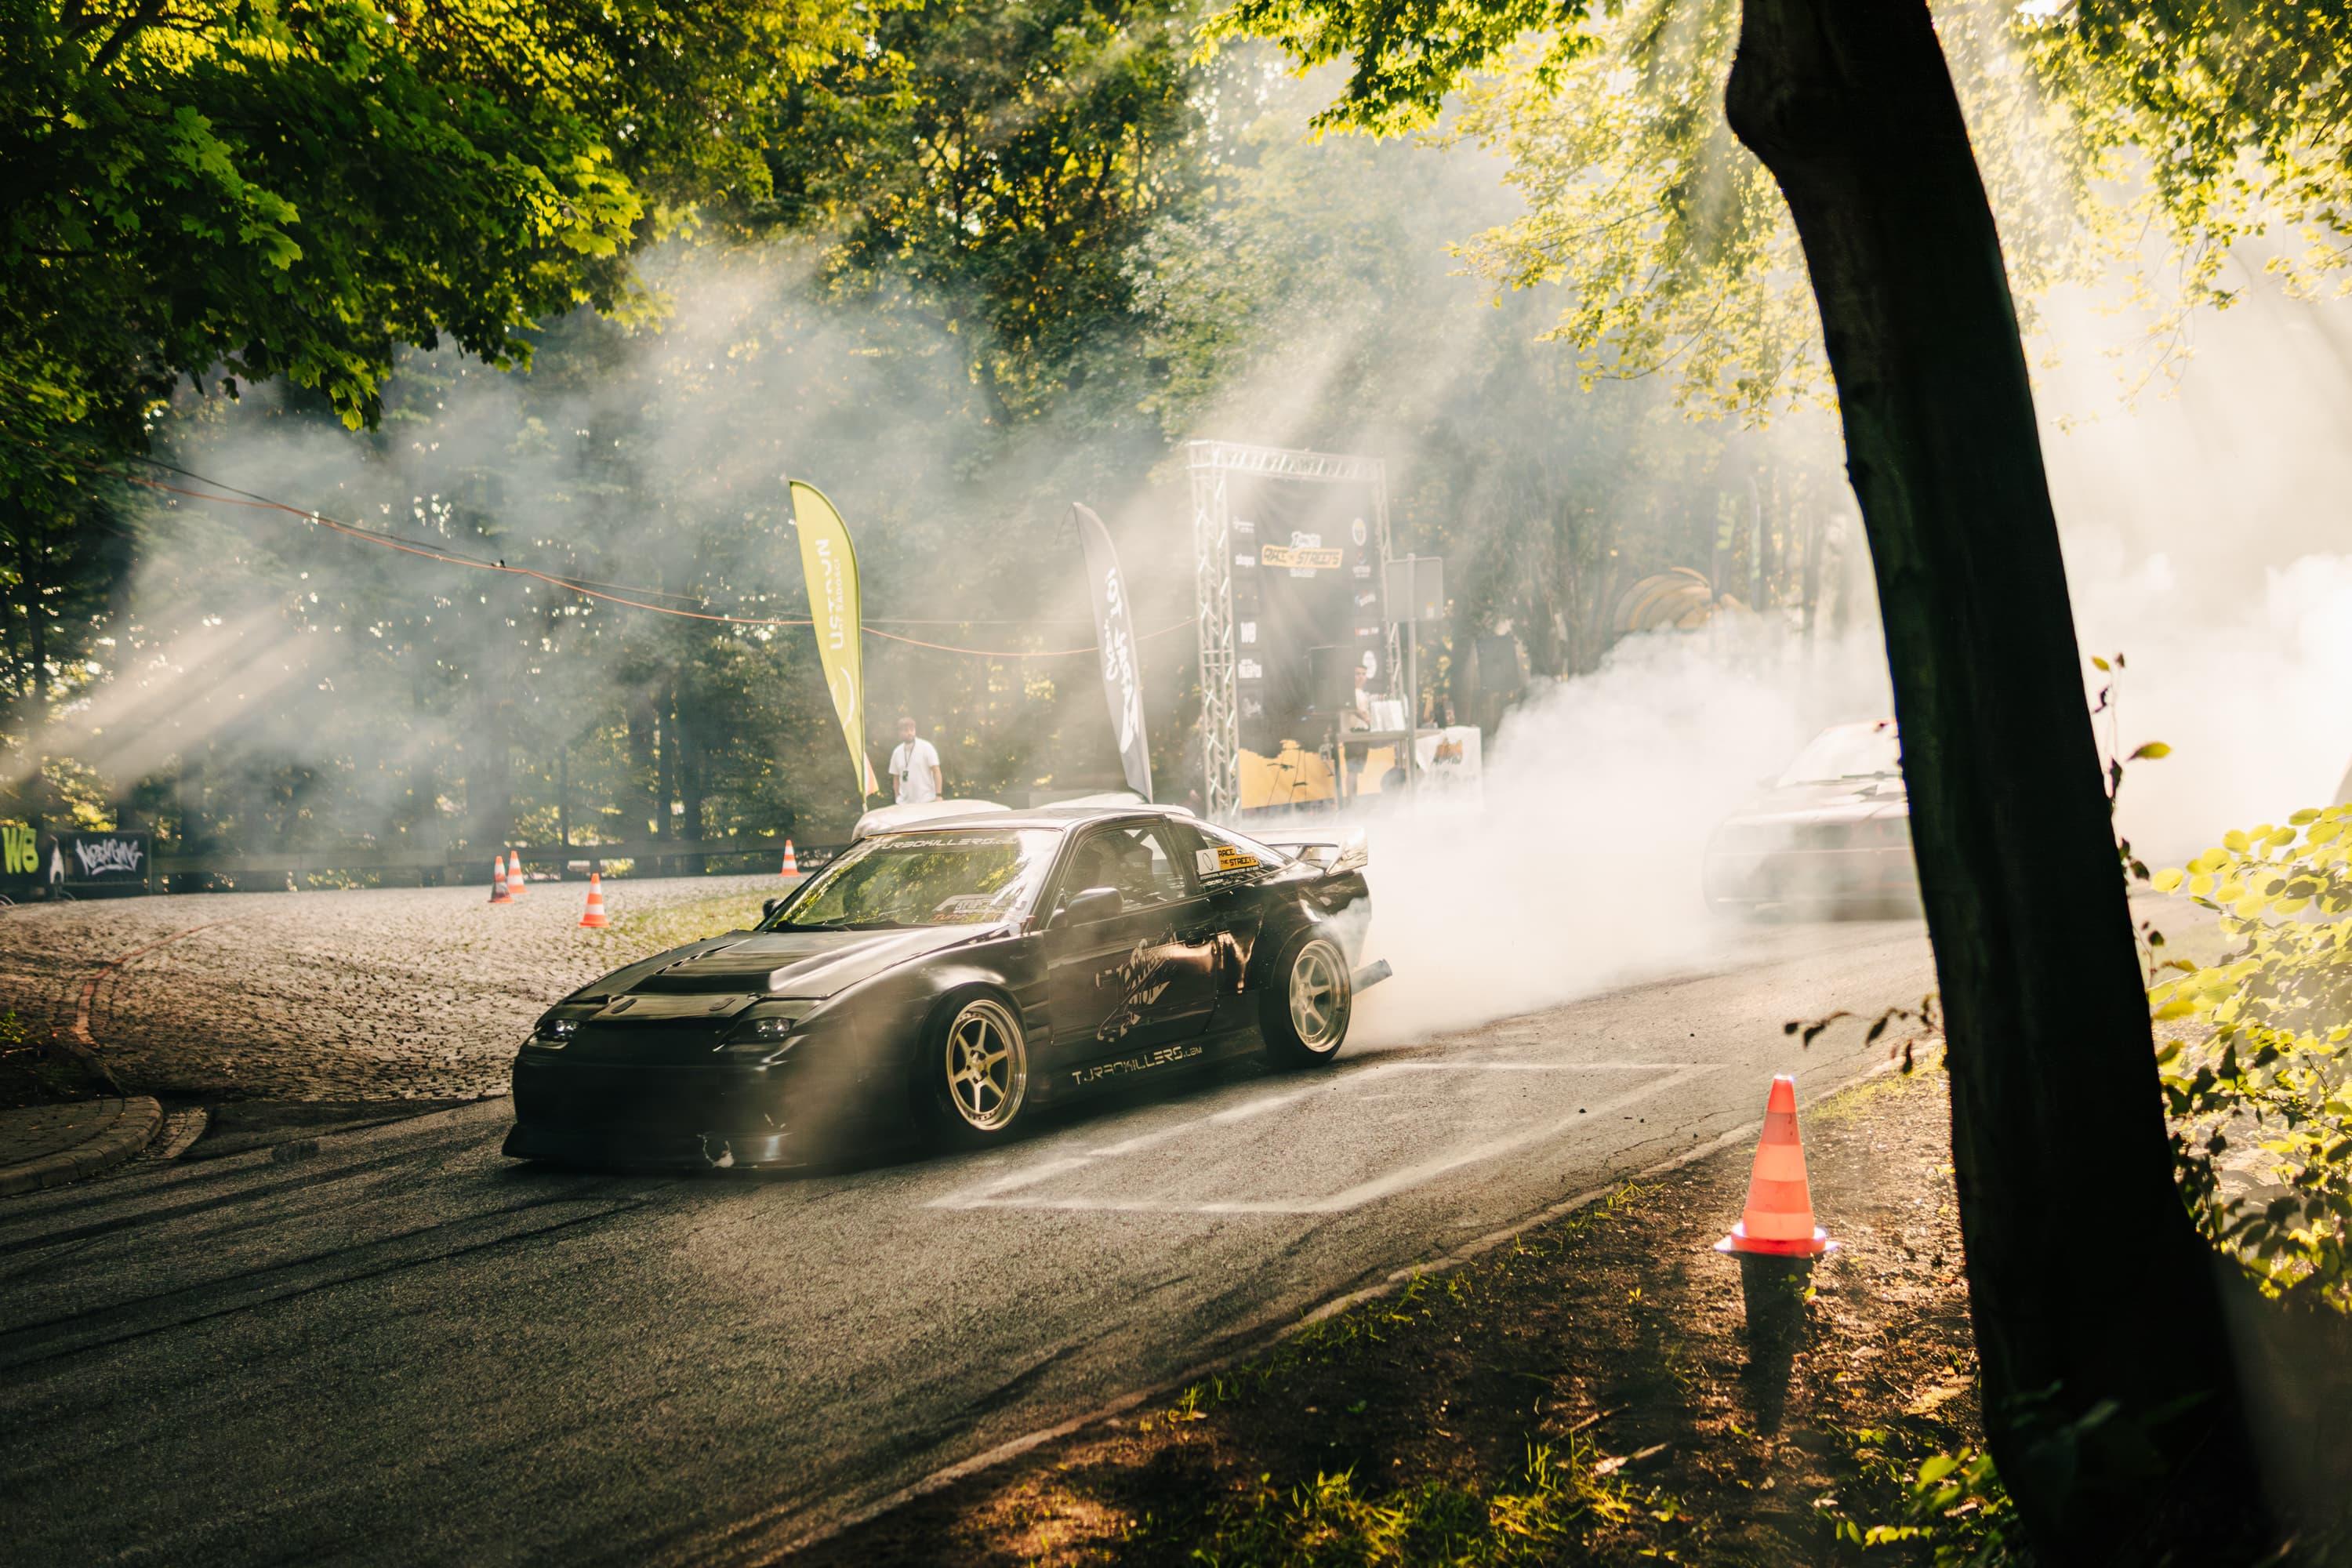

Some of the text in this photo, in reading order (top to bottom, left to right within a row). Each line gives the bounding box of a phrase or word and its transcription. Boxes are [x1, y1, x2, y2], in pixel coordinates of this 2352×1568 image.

[2, 827, 39, 874] WB
[1218, 848, 1235, 858] RACE
[1229, 856, 1257, 866] STREETS
